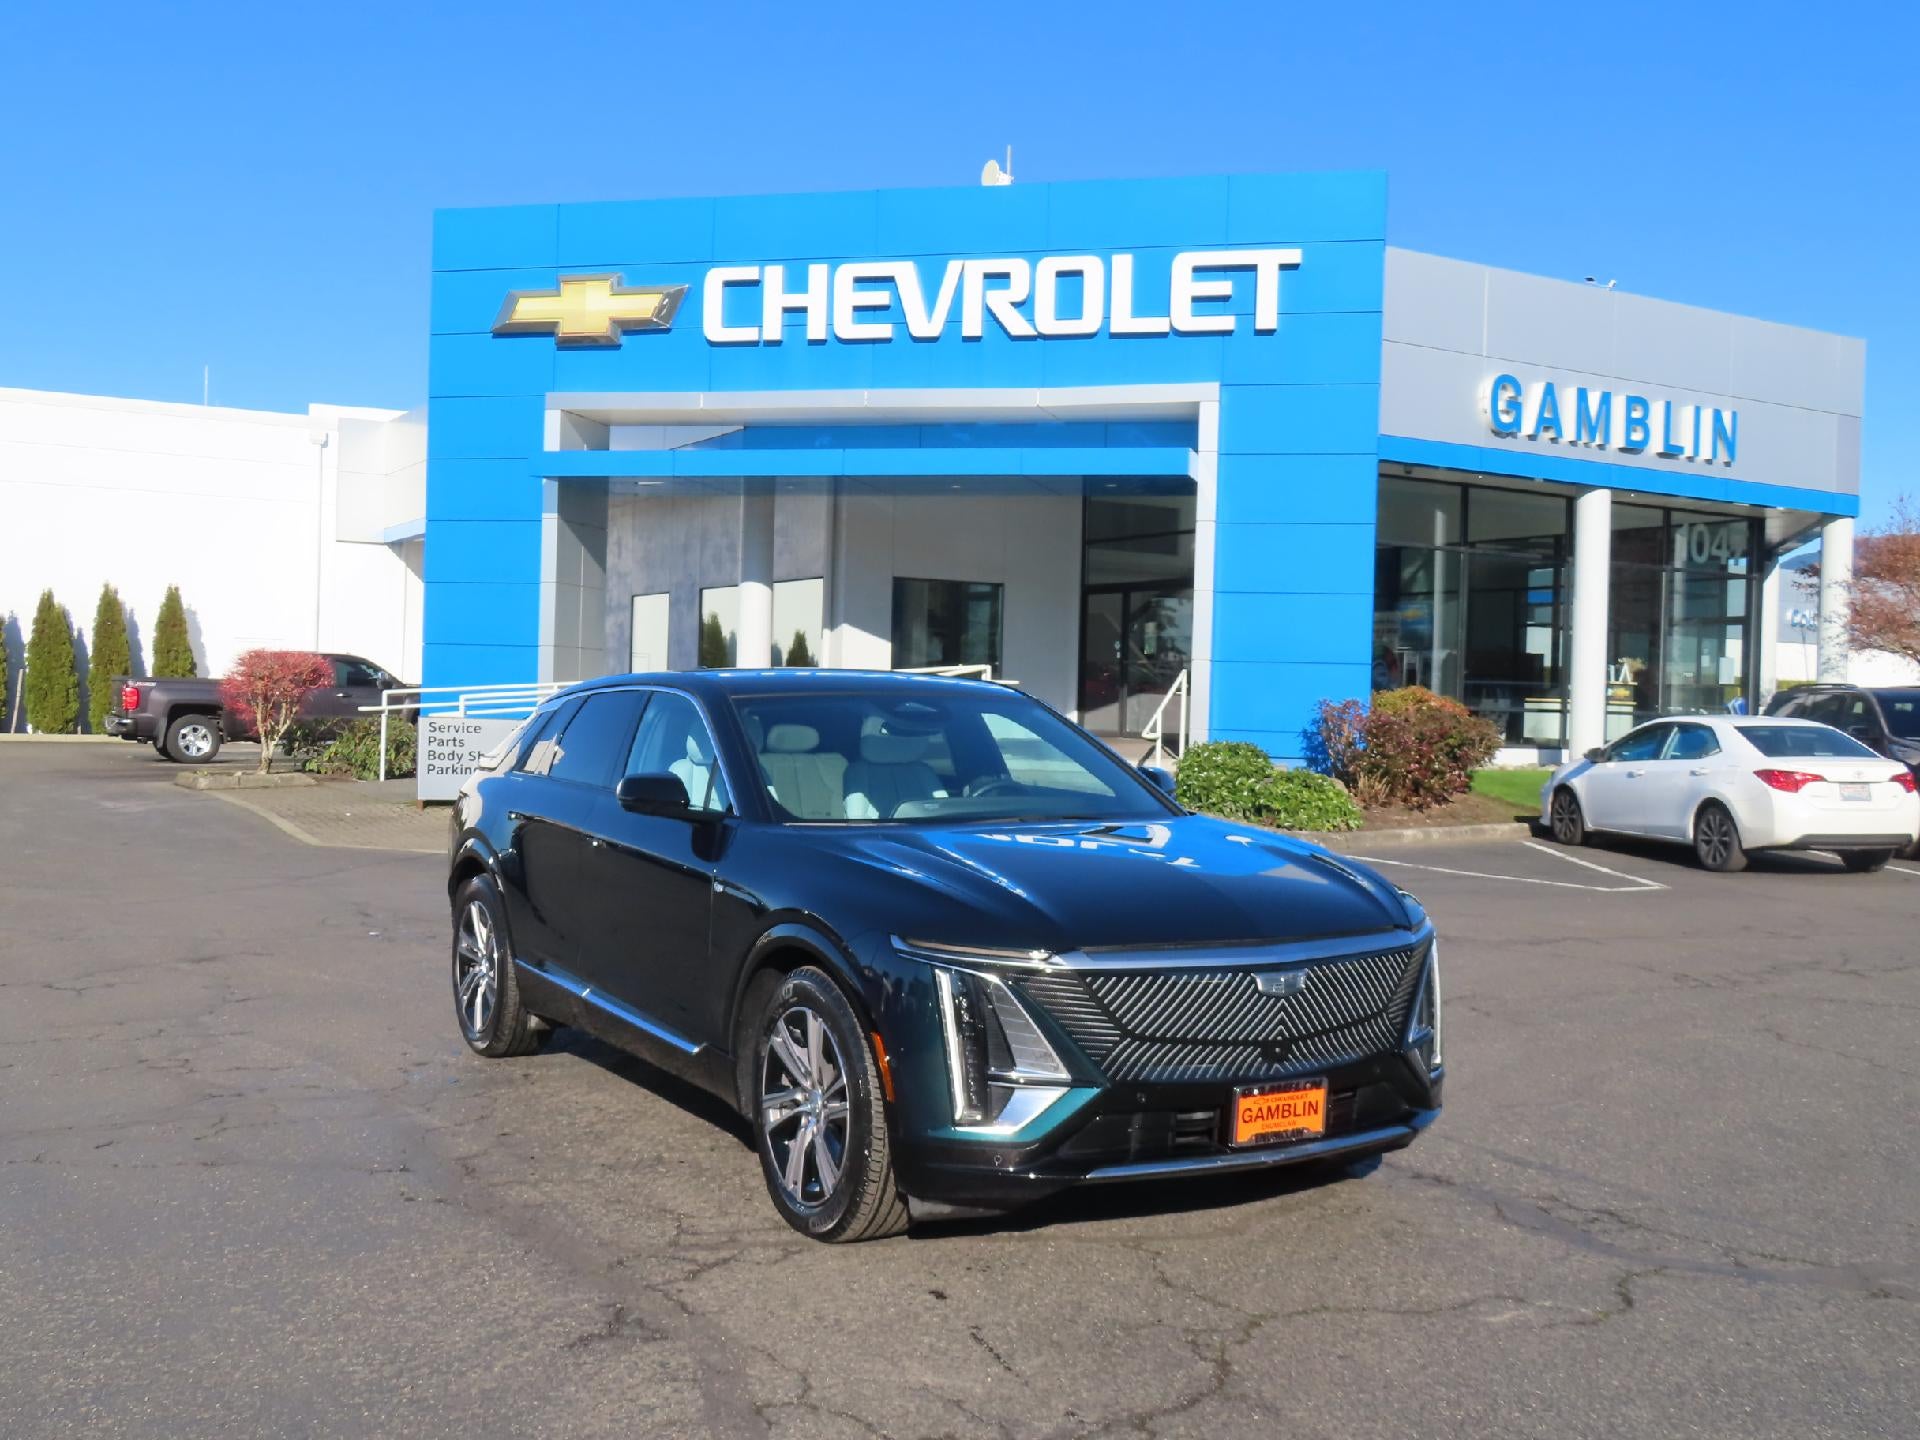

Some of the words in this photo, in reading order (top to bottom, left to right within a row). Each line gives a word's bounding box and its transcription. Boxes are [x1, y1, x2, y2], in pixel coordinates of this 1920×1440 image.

[702, 248, 1302, 346] CHEVROLET
[1488, 373, 1738, 466] GAMBLIN
[428, 721, 482, 734] Service
[428, 735, 465, 748] Parts
[427, 749, 464, 765] Body
[1241, 1099, 1319, 1124] GAMBLIN
